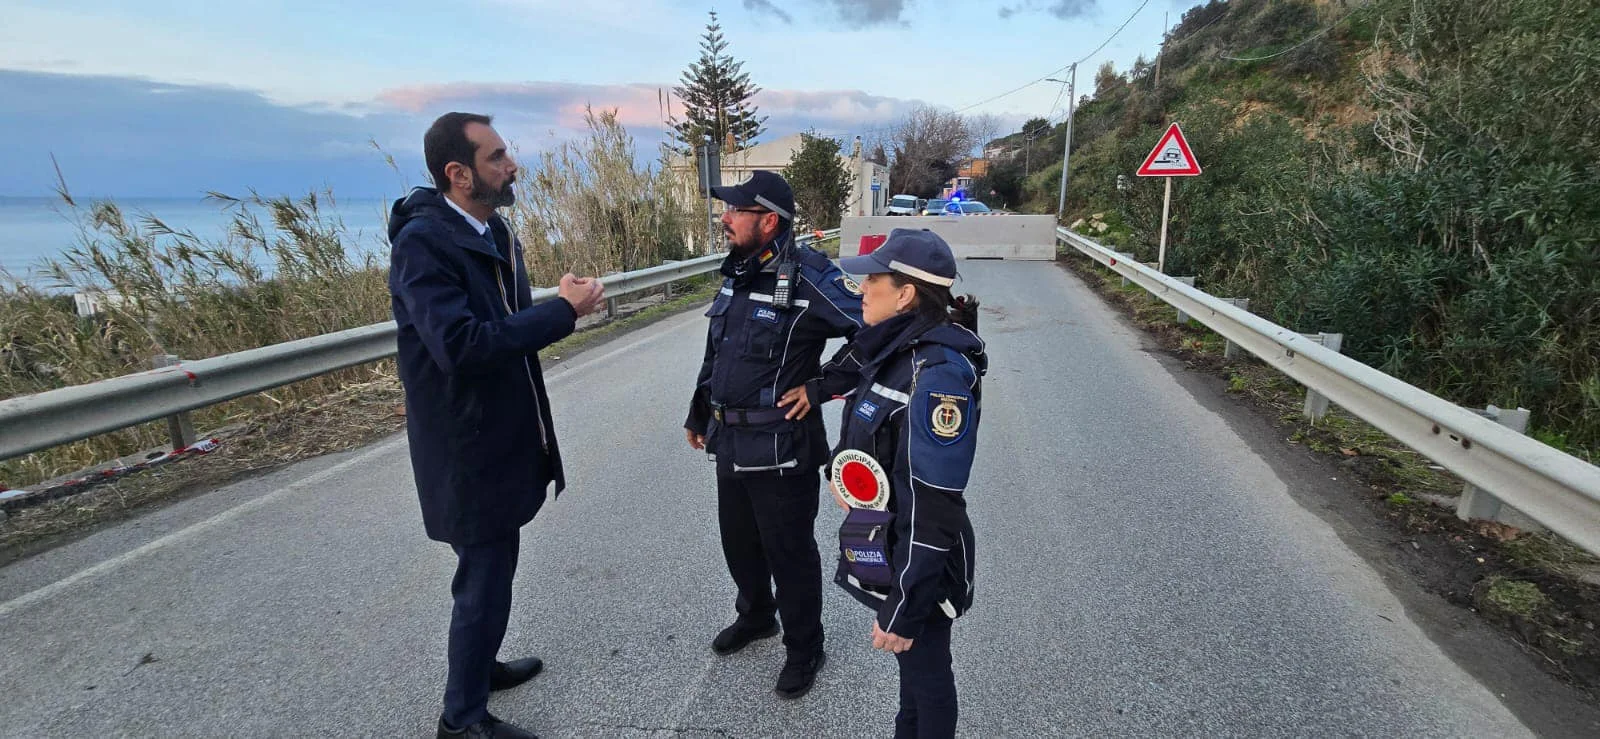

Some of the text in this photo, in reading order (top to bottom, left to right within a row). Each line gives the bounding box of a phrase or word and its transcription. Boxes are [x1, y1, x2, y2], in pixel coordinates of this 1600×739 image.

[837, 453, 881, 476] MUNICIPALE
[834, 467, 850, 499] POLIZIA
[854, 550, 882, 558] POLIZIA
